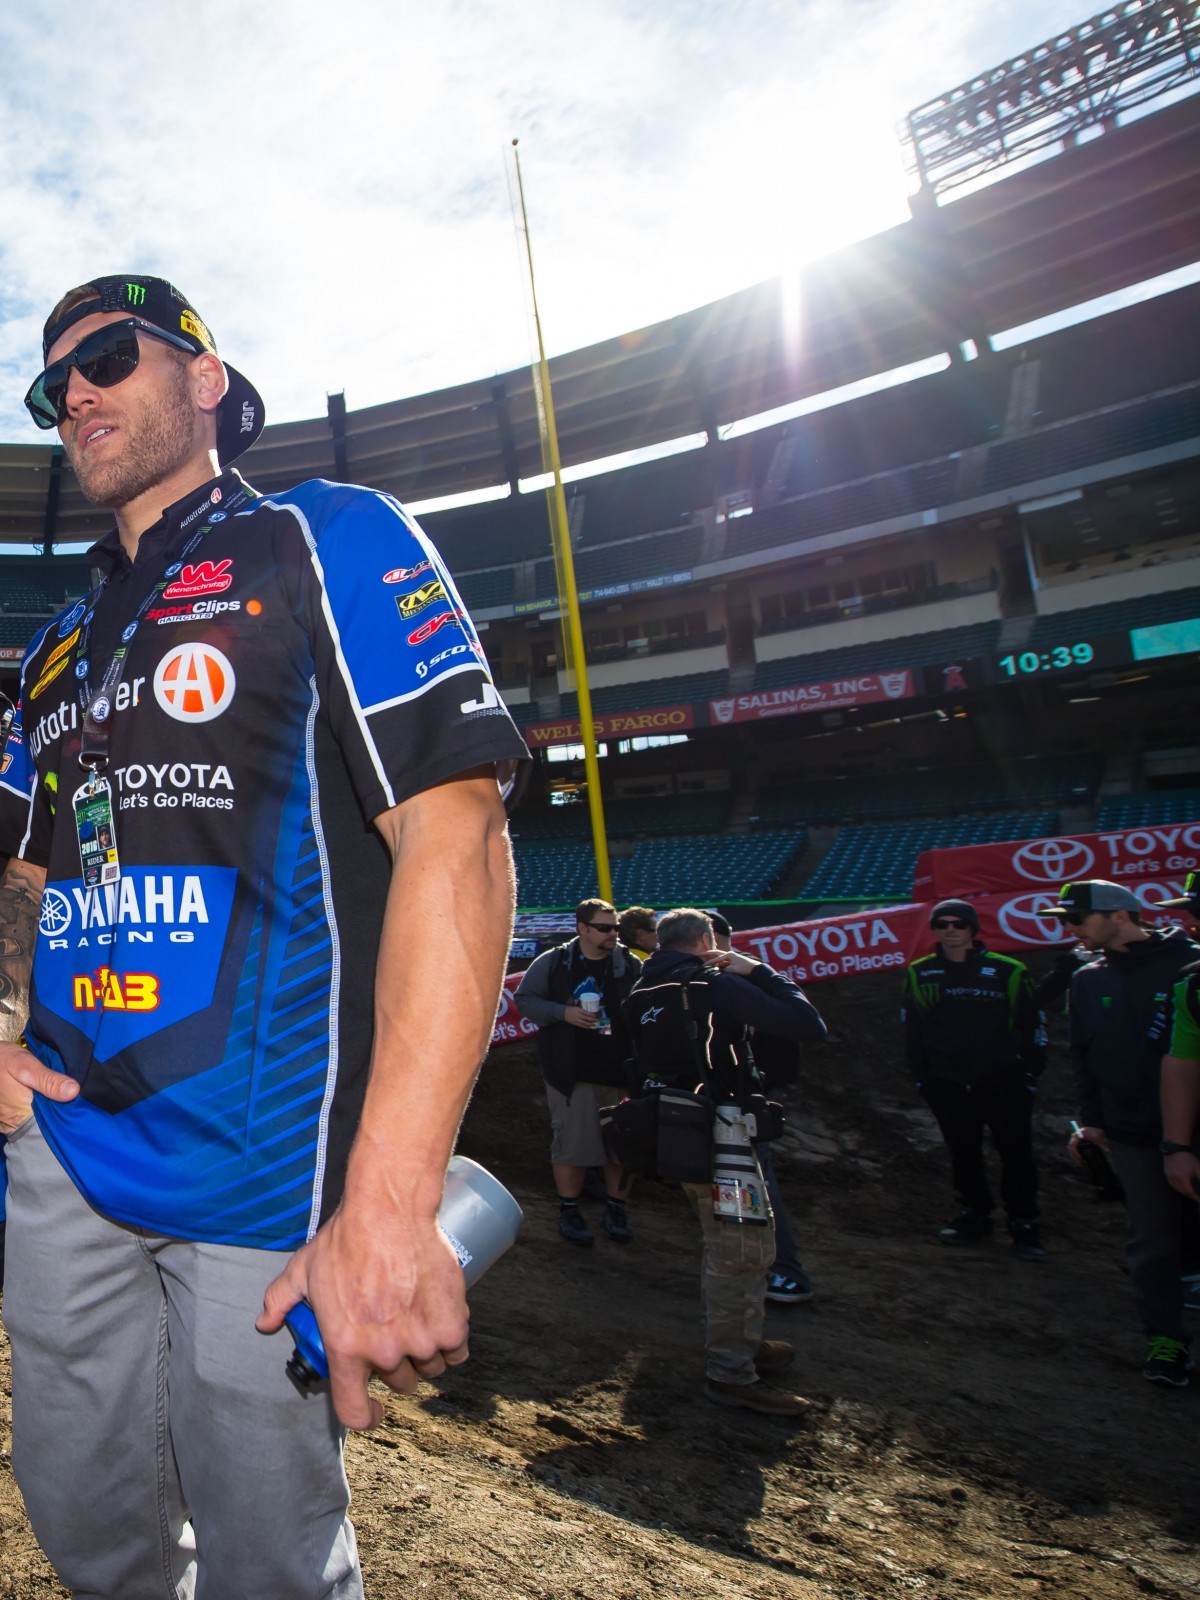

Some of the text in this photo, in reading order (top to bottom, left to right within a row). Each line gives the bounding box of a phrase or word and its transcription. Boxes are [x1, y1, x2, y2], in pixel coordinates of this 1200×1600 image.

[240, 401, 255, 433] JGR
[181, 499, 211, 529] Autotrader
[166, 579, 229, 595] Wienerschnitzel
[1000, 643, 1094, 676] 10:39
[738, 678, 878, 710] SALINAS, INC.
[610, 711, 686, 732] FARGO
[759, 704, 798, 717] General
[115, 763, 235, 791] TOYOTA
[120, 793, 234, 810] Let's Go Places
[81, 840, 98, 855] 2016
[1098, 826, 1200, 858] TOYO
[87, 855, 104, 866] RIDER
[1111, 855, 1198, 875] Let's Go
[72, 876, 209, 930] YAMAHA
[49, 931, 195, 949] RACING
[750, 919, 899, 964] TOYOTA
[811, 960, 839, 978] Go
[842, 951, 905, 973] Places
